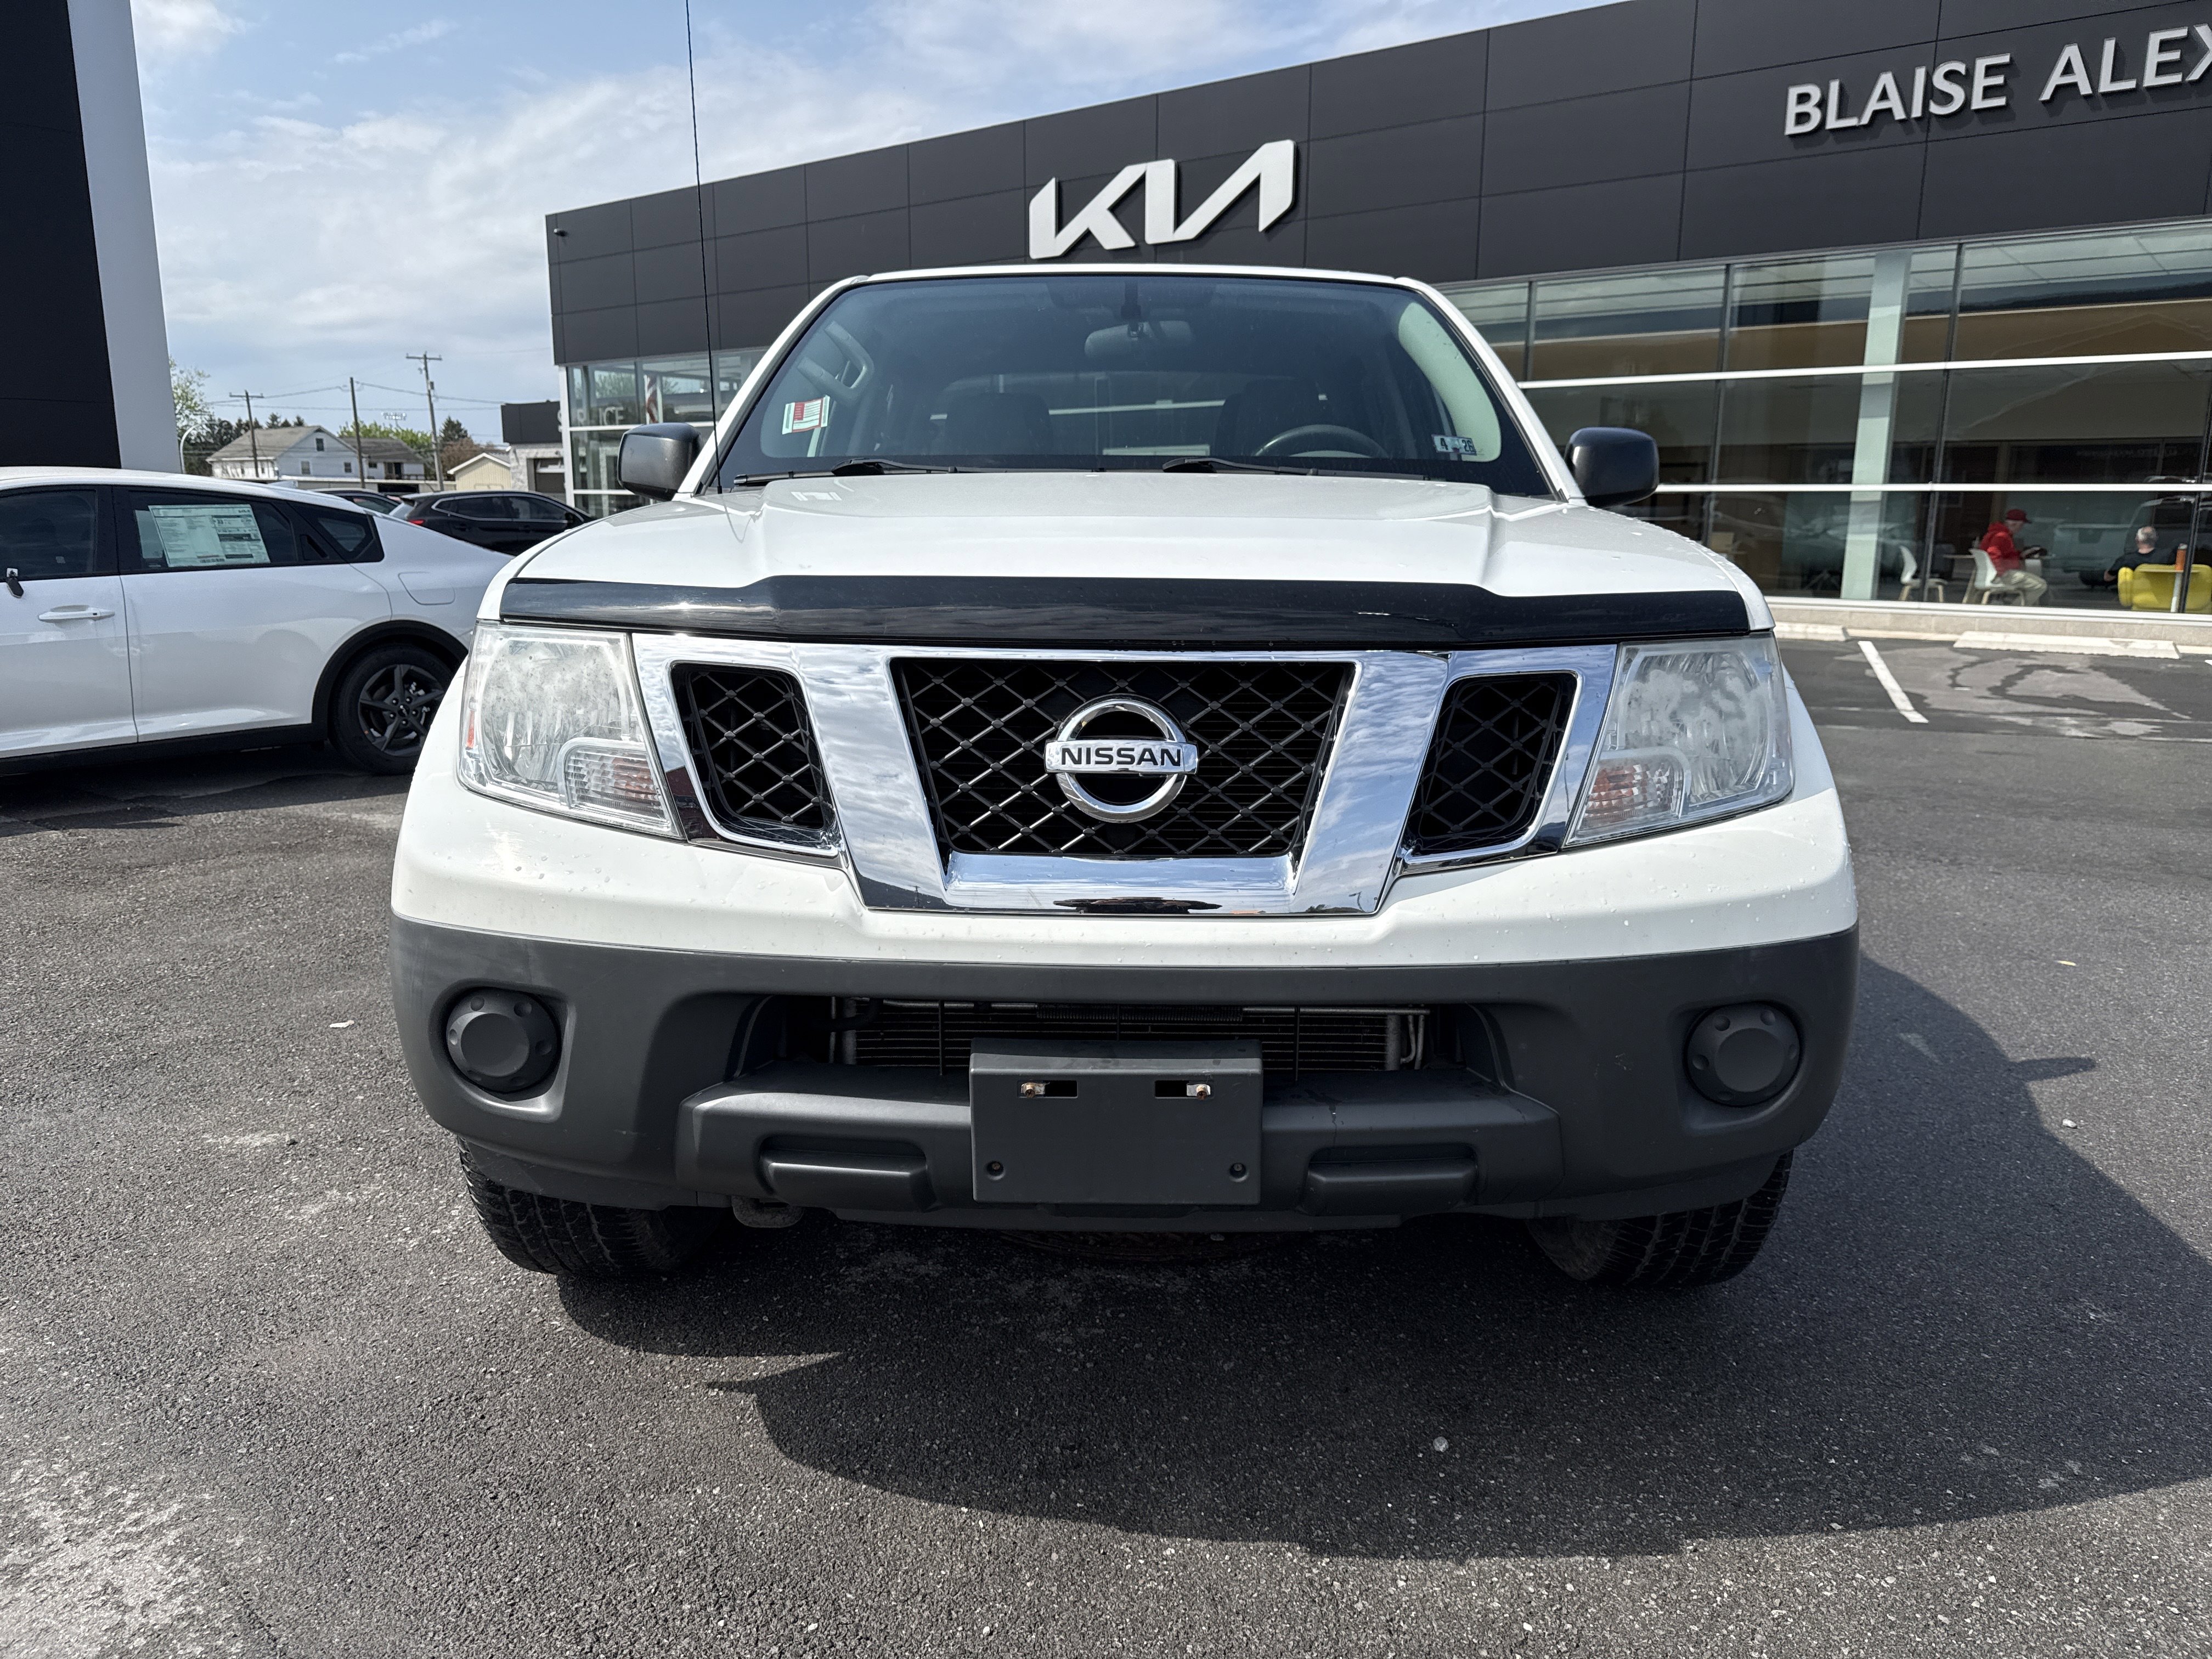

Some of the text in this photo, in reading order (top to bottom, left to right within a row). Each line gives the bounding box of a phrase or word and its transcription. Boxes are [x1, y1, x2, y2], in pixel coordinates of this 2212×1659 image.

[1784, 53, 2011, 136] BLAISE
[1029, 139, 1296, 259] KIA
[1440, 438, 1476, 452] 4 26
[1061, 747, 1181, 767] NISSAN
